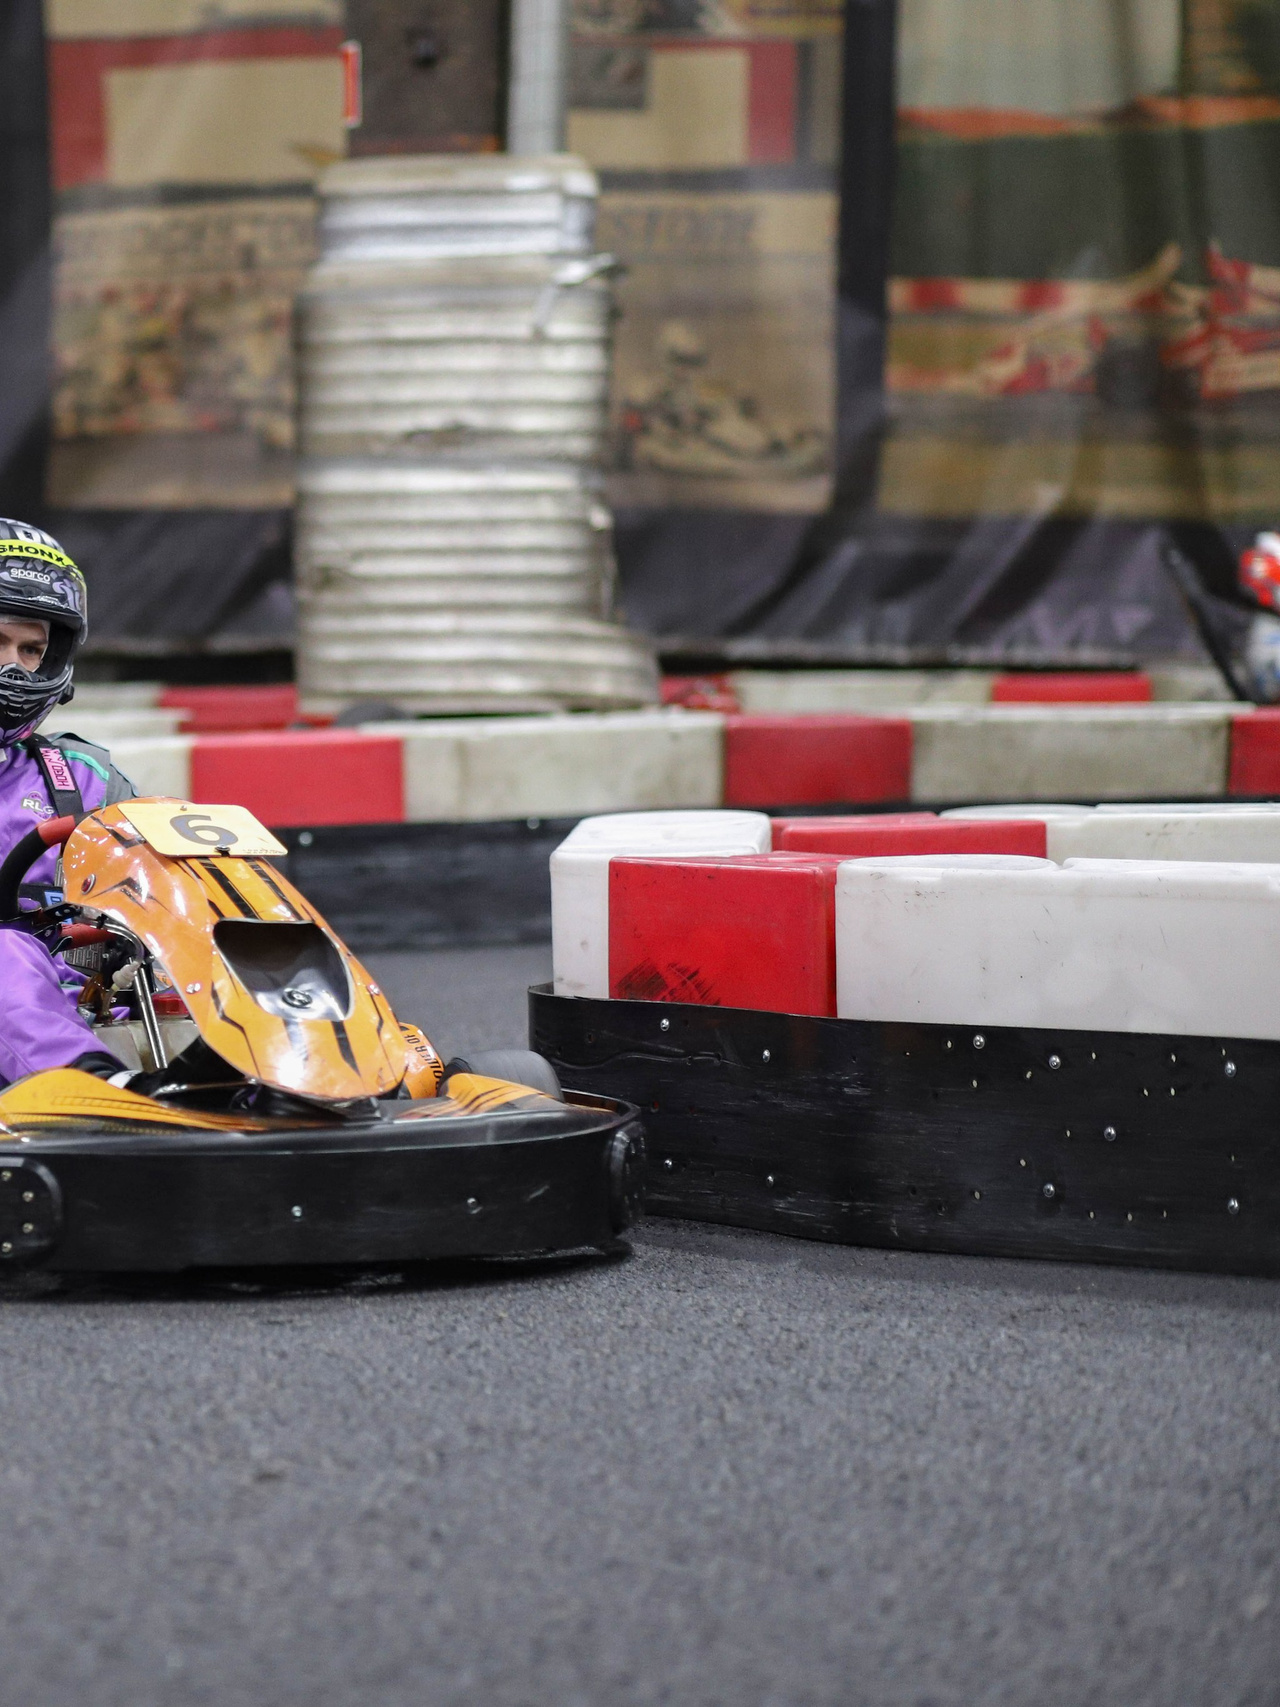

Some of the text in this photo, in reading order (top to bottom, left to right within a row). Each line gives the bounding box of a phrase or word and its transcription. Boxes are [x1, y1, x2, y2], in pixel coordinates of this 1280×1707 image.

[10, 567, 51, 582] sparco
[22, 798, 54, 814] RLG
[170, 814, 238, 846] 6
